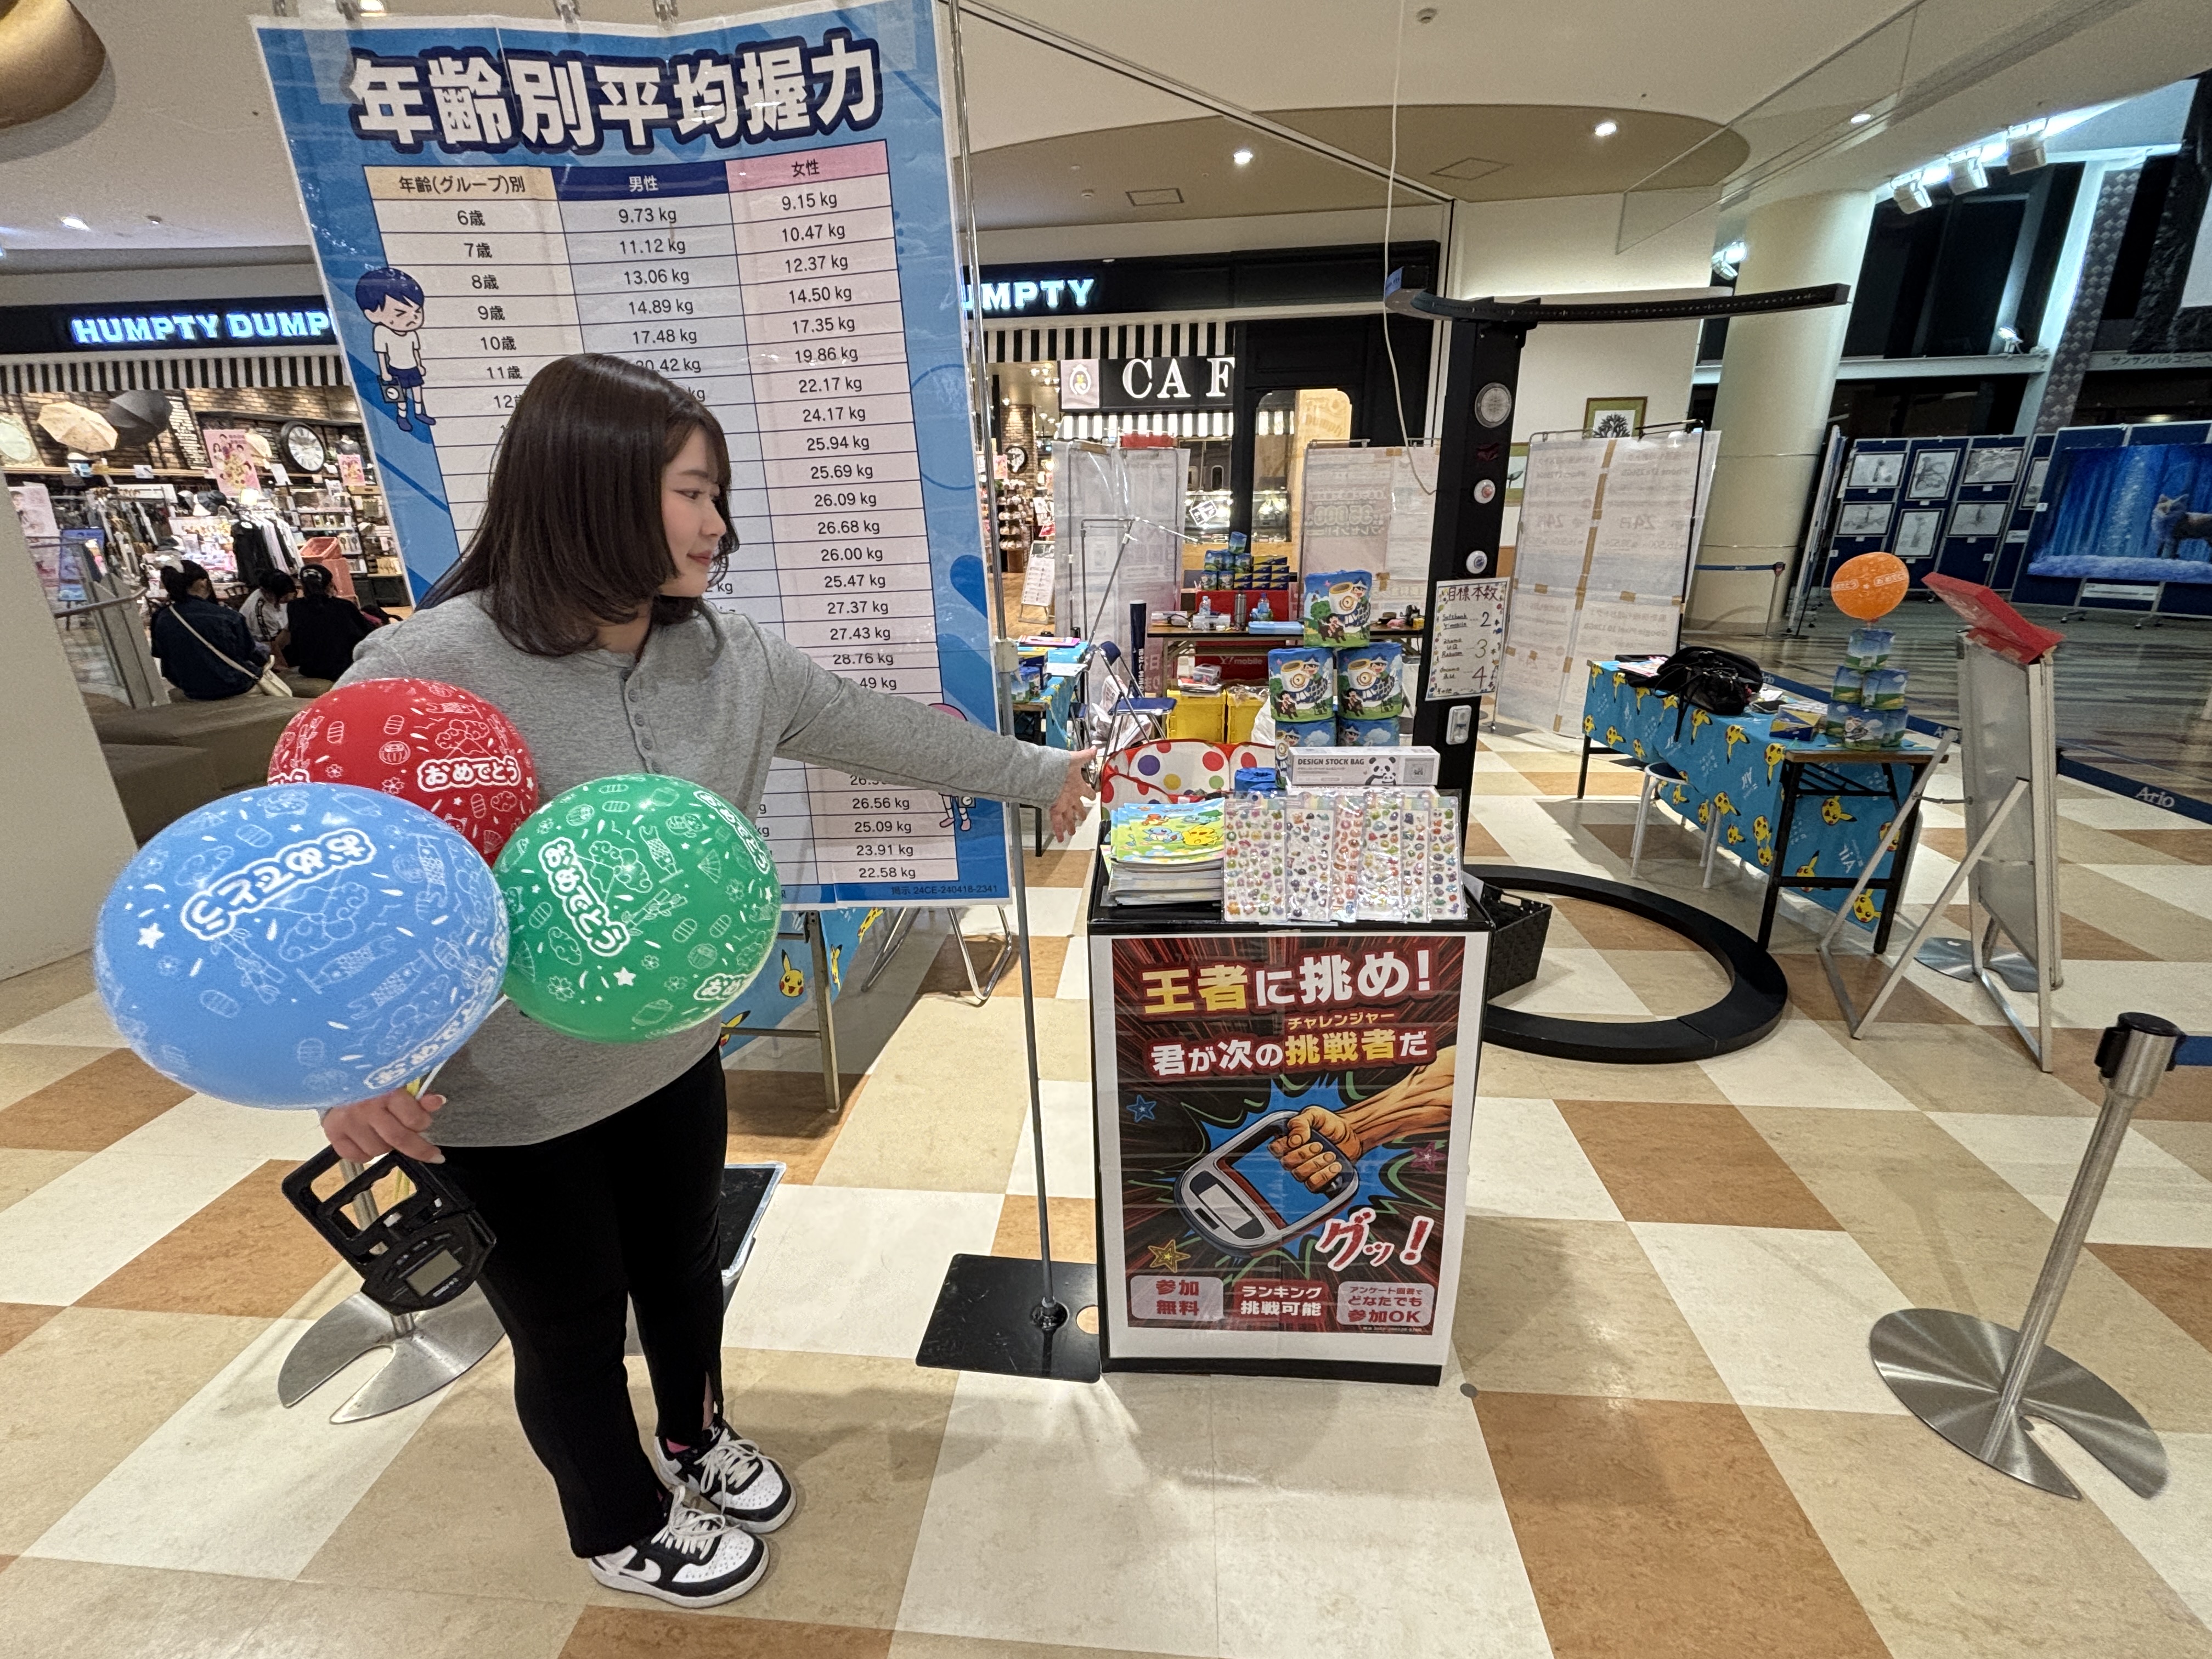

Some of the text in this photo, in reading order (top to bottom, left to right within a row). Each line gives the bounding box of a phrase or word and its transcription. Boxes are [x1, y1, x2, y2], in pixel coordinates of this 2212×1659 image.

[349, 36, 877, 146] 年齢別平均握力
[792, 160, 820, 177] 女性
[399, 176, 525, 194] 年齢(グループ)別
[629, 176, 658, 192] 男性
[781, 191, 838, 211] 9.15 kg
[456, 209, 486, 227] 6歳
[618, 207, 676, 224] 9.73 kg
[781, 223, 846, 242] 10.47 kg
[463, 242, 493, 259] 7歳
[619, 238, 686, 255] 11.12 kg
[785, 253, 848, 274] 12.37 kg
[471, 274, 500, 290] 8歳
[623, 267, 690, 285] 13.06 kg
[788, 285, 852, 304] 14.50 kg
[477, 305, 506, 321] 9歳
[628, 298, 694, 315] 14.89 kg
[71, 311, 331, 344] HUMPTY DUMP
[792, 315, 855, 335] 17.35 kg
[480, 335, 517, 351] 10歳
[632, 328, 697, 345] 17.48 kg
[795, 346, 859, 363] 19.86 kg
[484, 365, 524, 380] 11歳
[684, 358, 701, 373] kg
[798, 376, 862, 394] 22.17 kg
[802, 405, 866, 423] 24.17 kg
[806, 435, 870, 452] 25.94 kg
[810, 463, 874, 479] 25.69 kg
[814, 492, 877, 507] 26.09 kg
[817, 519, 881, 535] 26.68 kg
[820, 546, 883, 562] 26.00 kg
[823, 573, 886, 589] 25.47 kg
[1448, 585, 1499, 602] 目標本数
[827, 600, 889, 615] 27.37 kg
[1480, 611, 1492, 627] 2
[830, 626, 891, 641] 27.43 kg
[1475, 639, 1488, 658] 3
[833, 652, 894, 666] 28.76 kg
[881, 676, 898, 691] kg
[1472, 665, 1487, 689] 4
[422, 757, 519, 787] おめでとう
[852, 797, 910, 811] 26.56 kg
[2135, 786, 2175, 808] Ario
[854, 820, 912, 834] 25.09 kg
[856, 842, 913, 856] 23.91 kg
[188, 829, 372, 933] おめでとう
[858, 866, 916, 879] 22.58 kg
[543, 841, 624, 952] おめでとう
[1288, 1012, 1395, 1030] チャレンジャー
[1151, 1028, 1427, 1076] 君が次の挑戦者だ
[1156, 1279, 1199, 1296] 参加
[1241, 1285, 1322, 1297] ランキング
[1350, 1286, 1422, 1295] アンケート回答で
[1156, 1300, 1200, 1316] 無料
[1240, 1301, 1322, 1317] 挑戦可能
[1347, 1296, 1423, 1307] どなたでも
[1347, 1310, 1420, 1324] 参加OK
